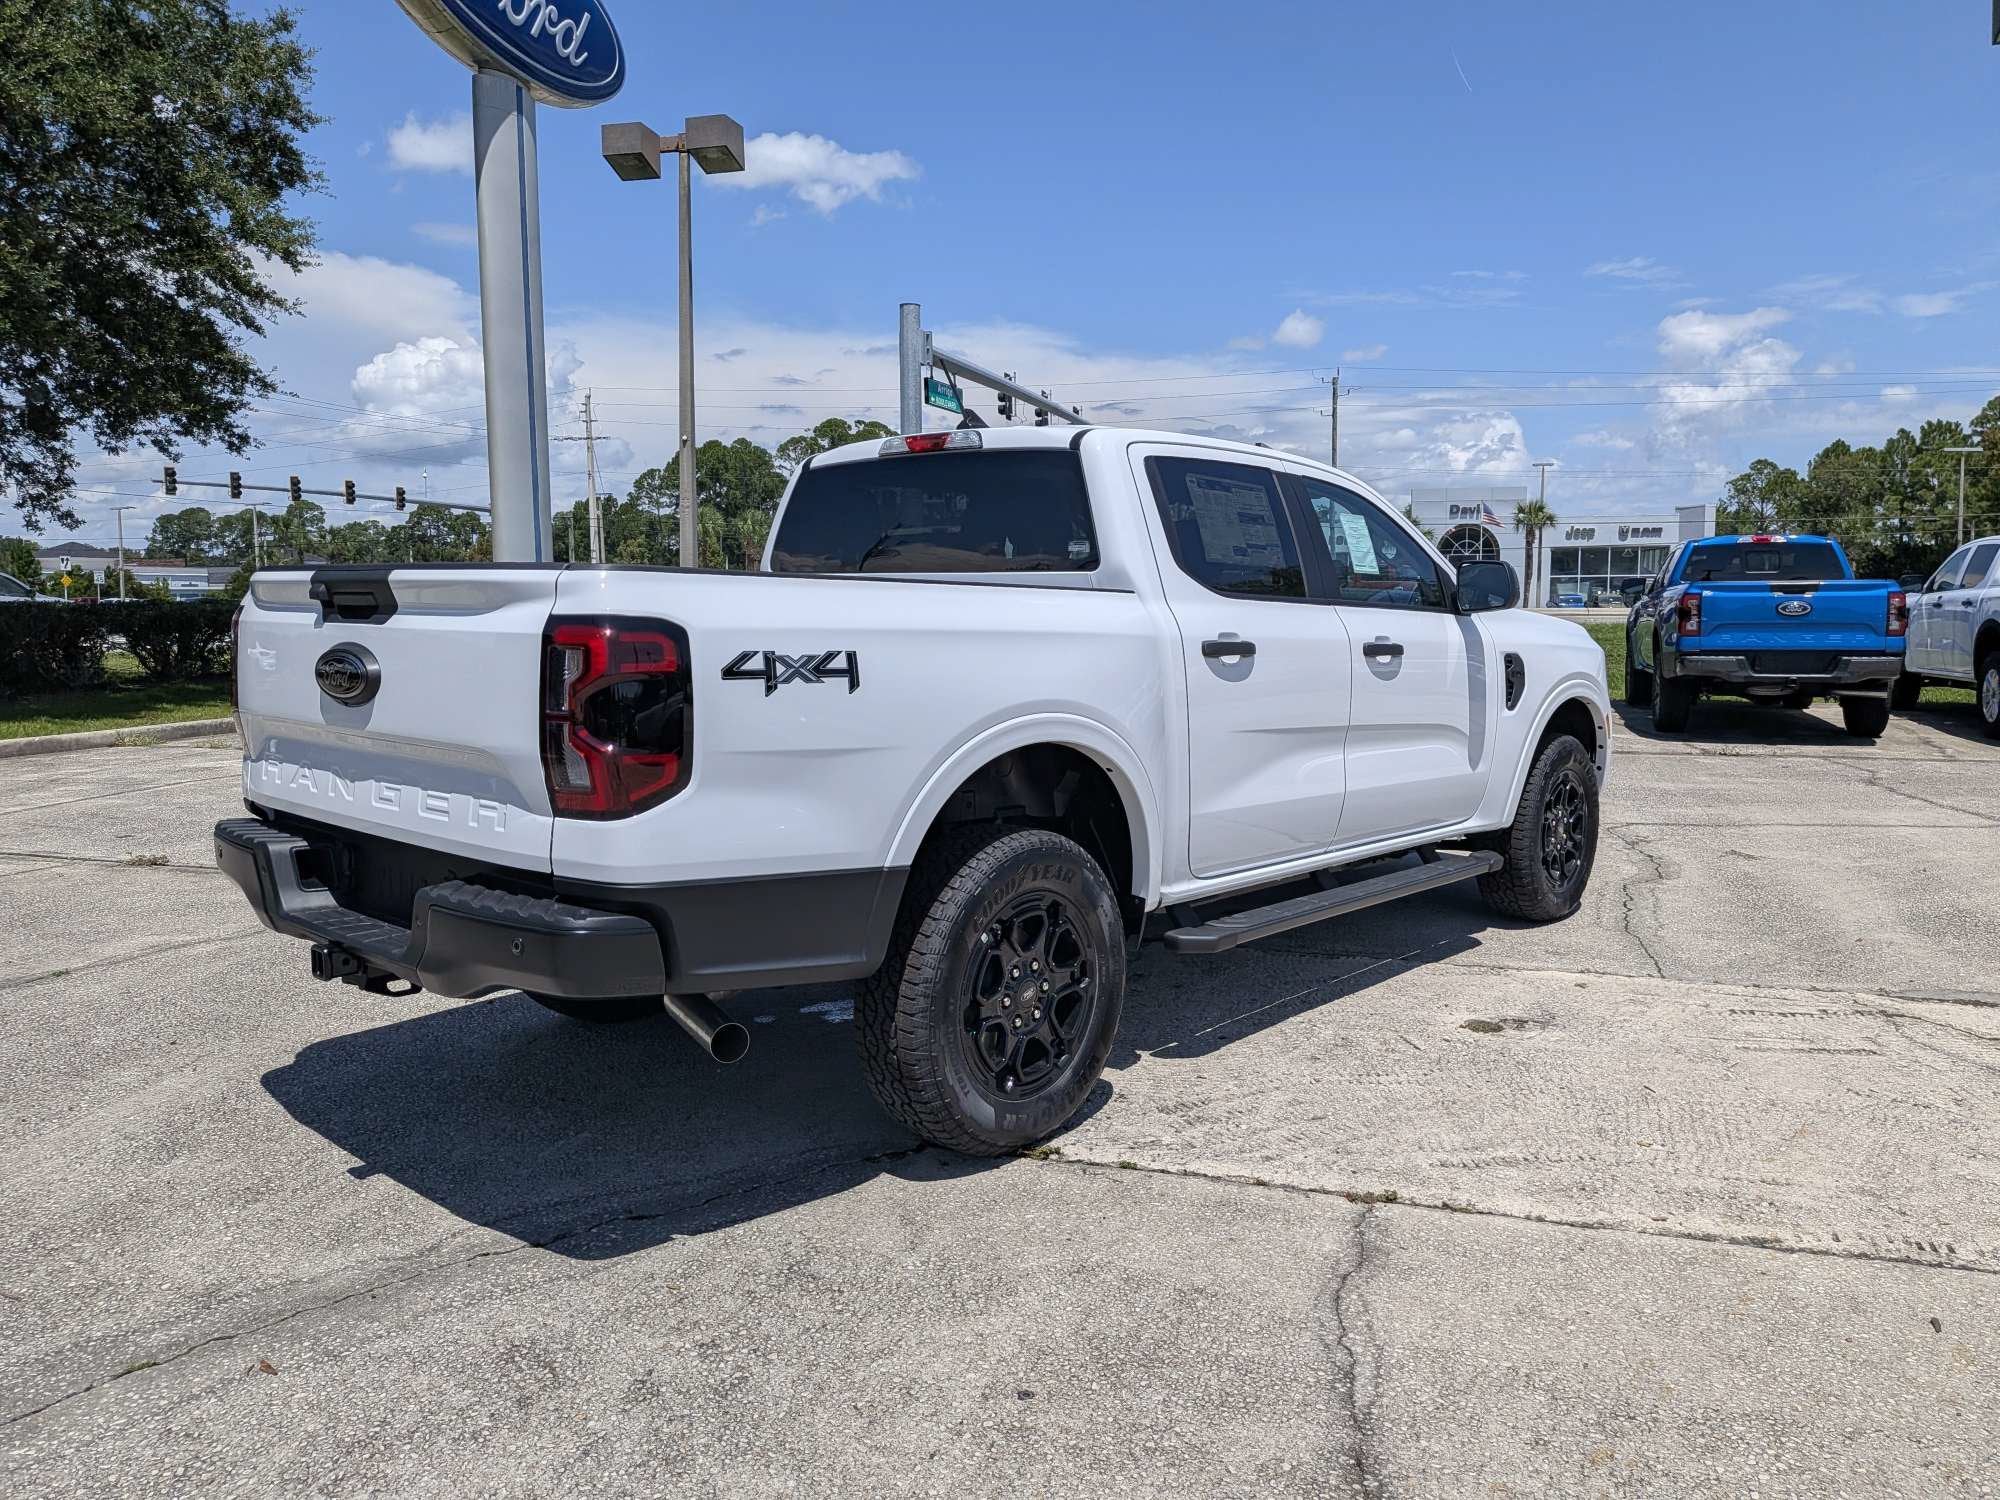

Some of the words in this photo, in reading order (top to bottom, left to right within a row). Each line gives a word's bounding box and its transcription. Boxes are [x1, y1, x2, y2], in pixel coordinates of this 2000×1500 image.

[498, 0, 591, 67] ord
[1449, 503, 1481, 520] Davi
[1565, 525, 1595, 542] Jeep
[319, 660, 357, 688] Ford
[261, 751, 508, 832] RANGER
